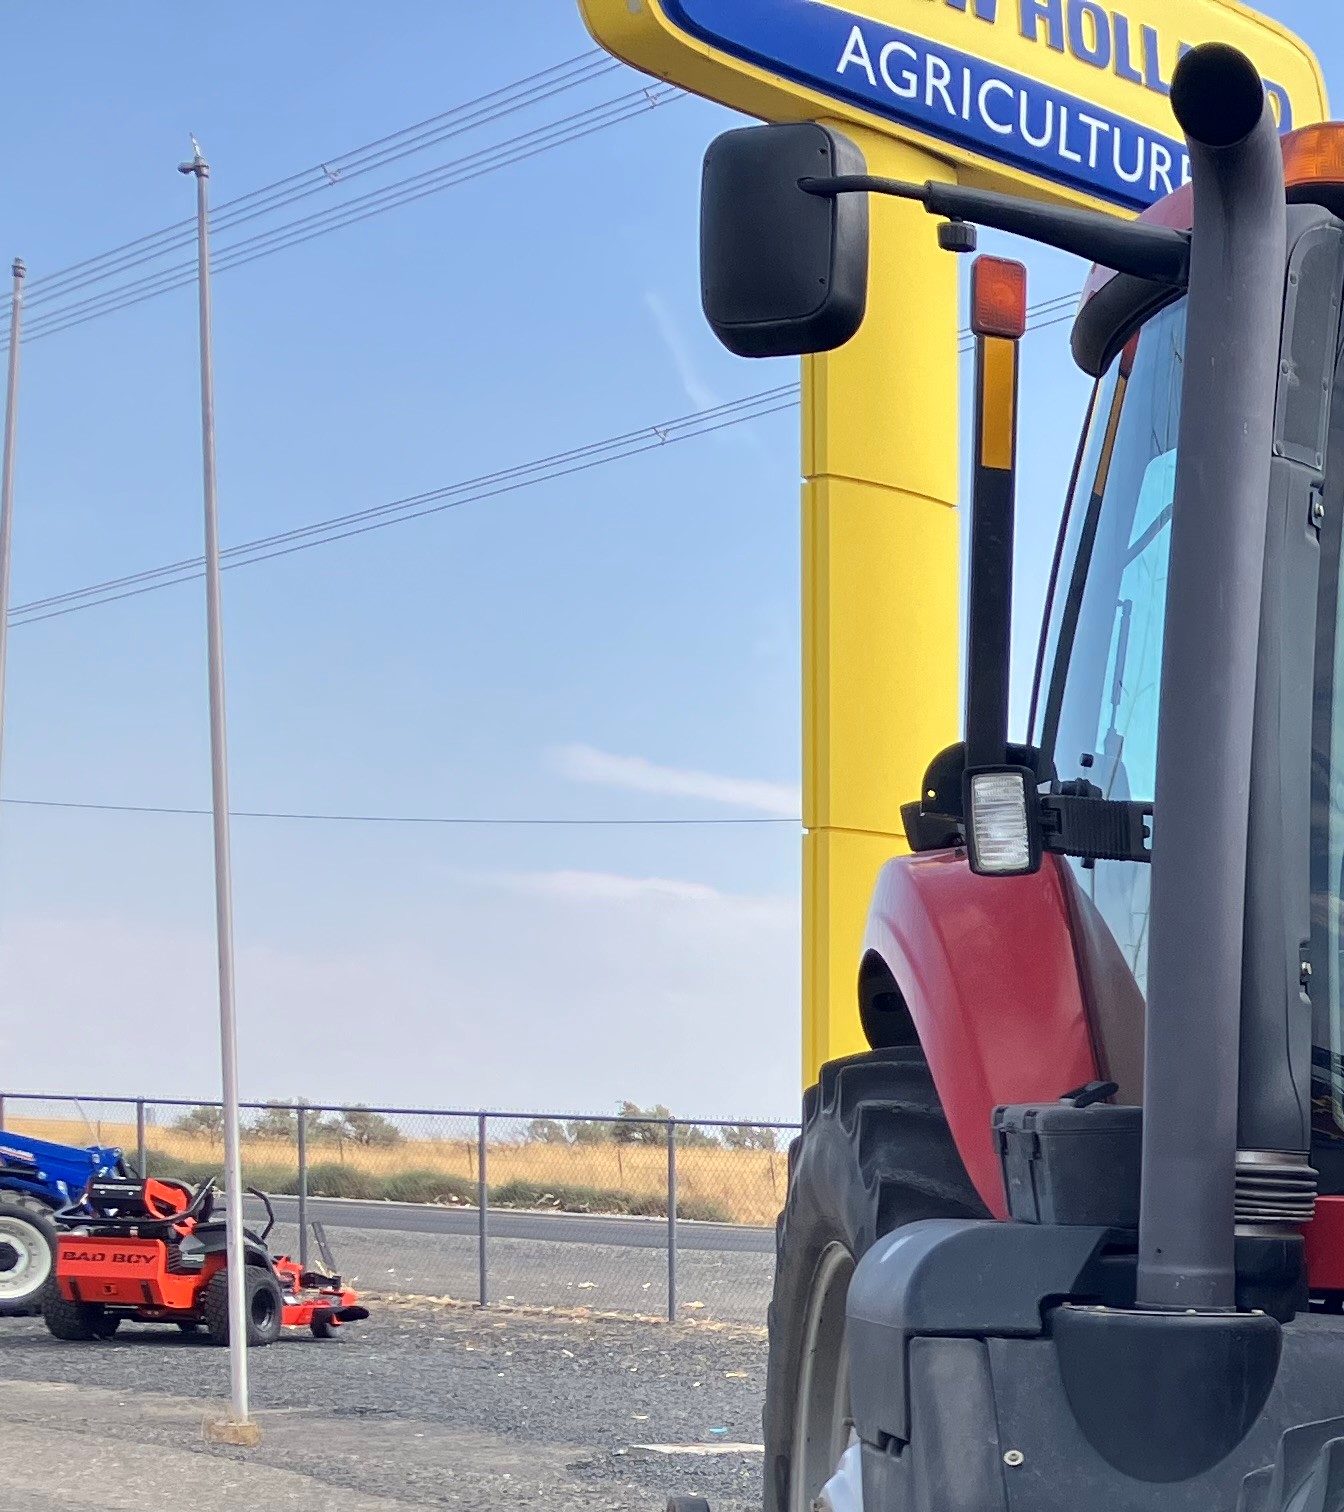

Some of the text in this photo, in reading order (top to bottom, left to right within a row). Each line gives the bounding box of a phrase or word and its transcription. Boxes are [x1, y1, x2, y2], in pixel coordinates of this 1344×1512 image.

[1018, 0, 1293, 132] HOLLD
[62, 1251, 156, 1264] BAD BOY
